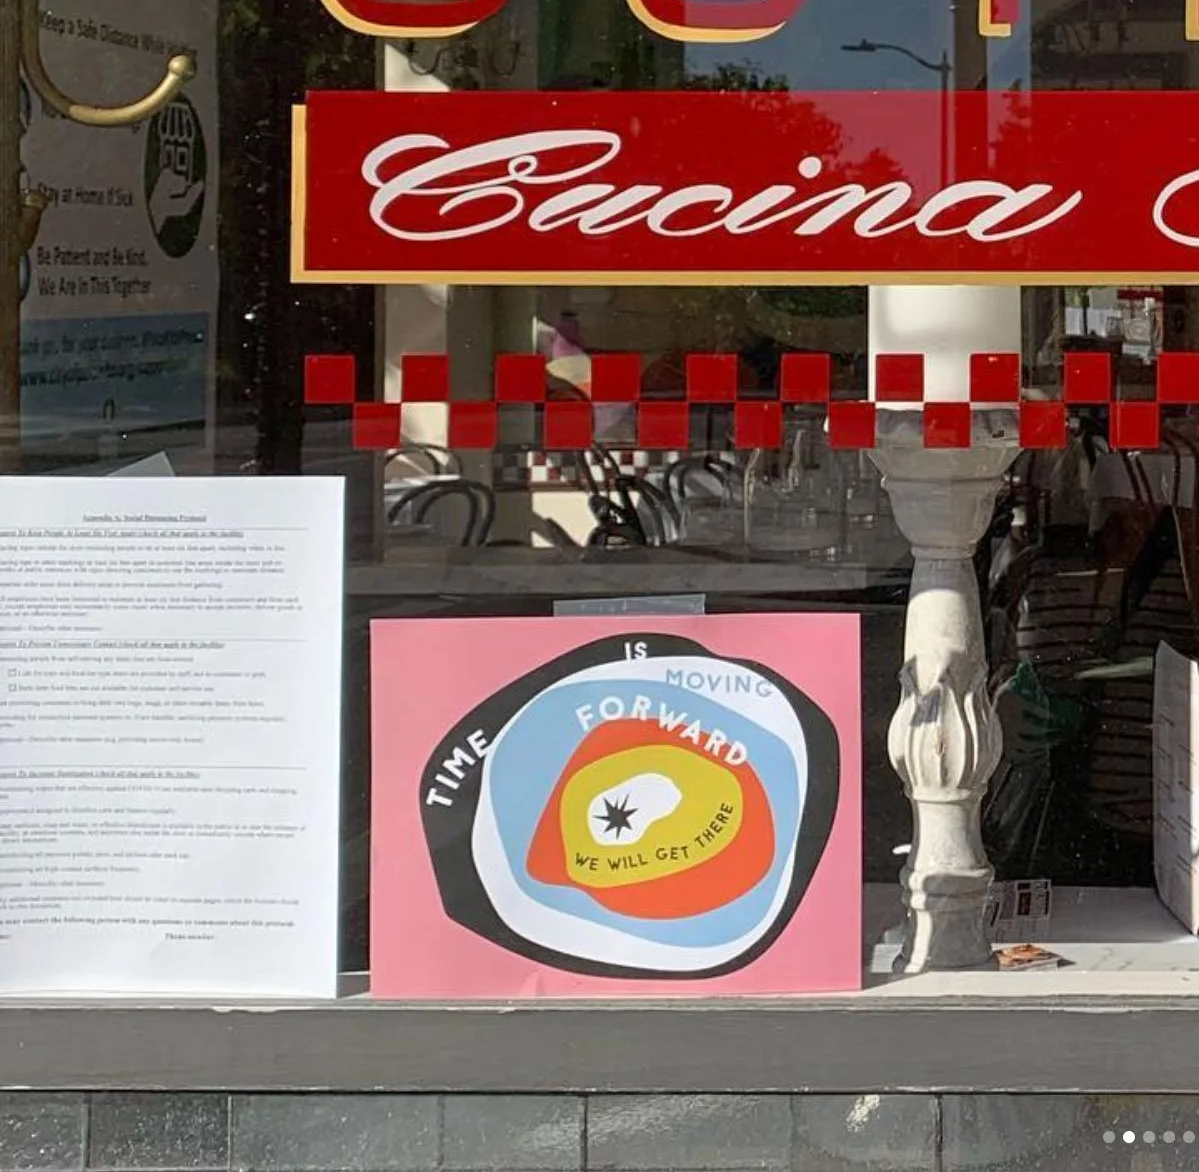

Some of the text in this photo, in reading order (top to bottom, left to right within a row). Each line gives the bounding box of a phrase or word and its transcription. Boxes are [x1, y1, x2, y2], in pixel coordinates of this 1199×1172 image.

[361, 129, 1083, 242] Cucina
[665, 667, 773, 699] MOVING
[426, 642, 648, 810] TIME IS
[575, 694, 750, 767] FORWARD
[574, 801, 734, 871] WE WILL GET THERE
